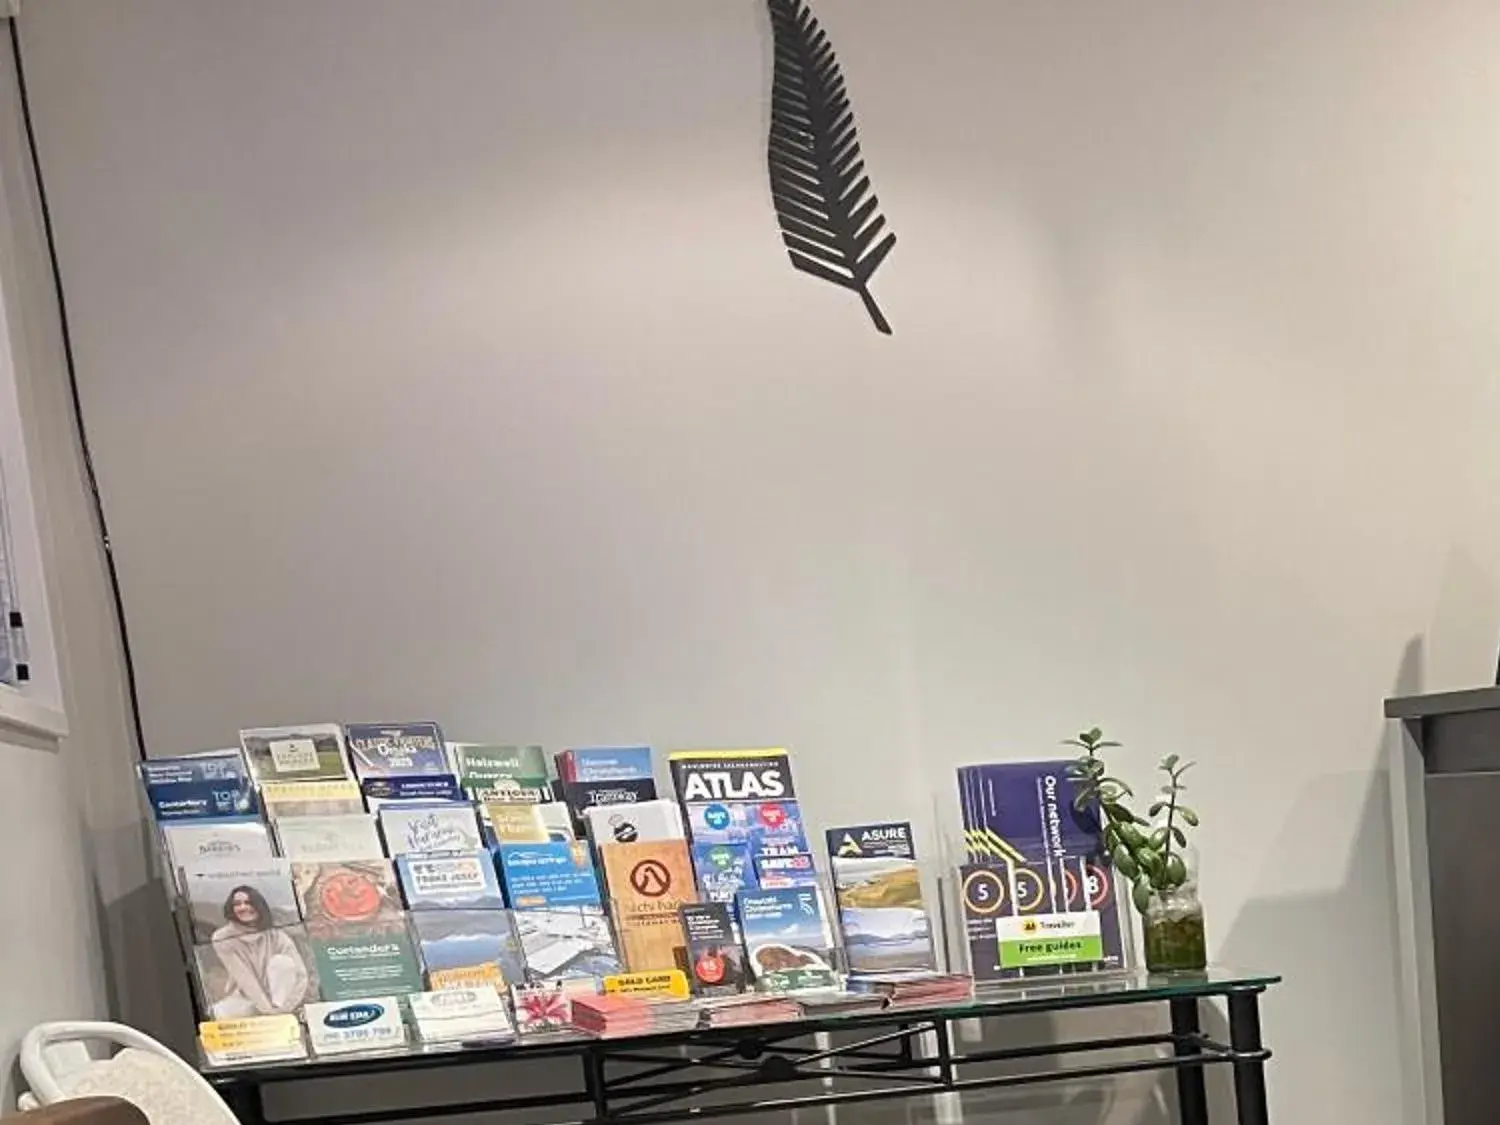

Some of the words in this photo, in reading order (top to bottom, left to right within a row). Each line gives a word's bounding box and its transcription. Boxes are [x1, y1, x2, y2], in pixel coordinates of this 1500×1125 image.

[685, 769, 785, 800] ATLAS
[1044, 775, 1057, 801] Our
[862, 827, 906, 841] ASURE
[1047, 802, 1067, 857] network
[1040, 920, 1076, 929] Traveller
[1019, 942, 1044, 954] Free
[1045, 940, 1083, 953] guides
